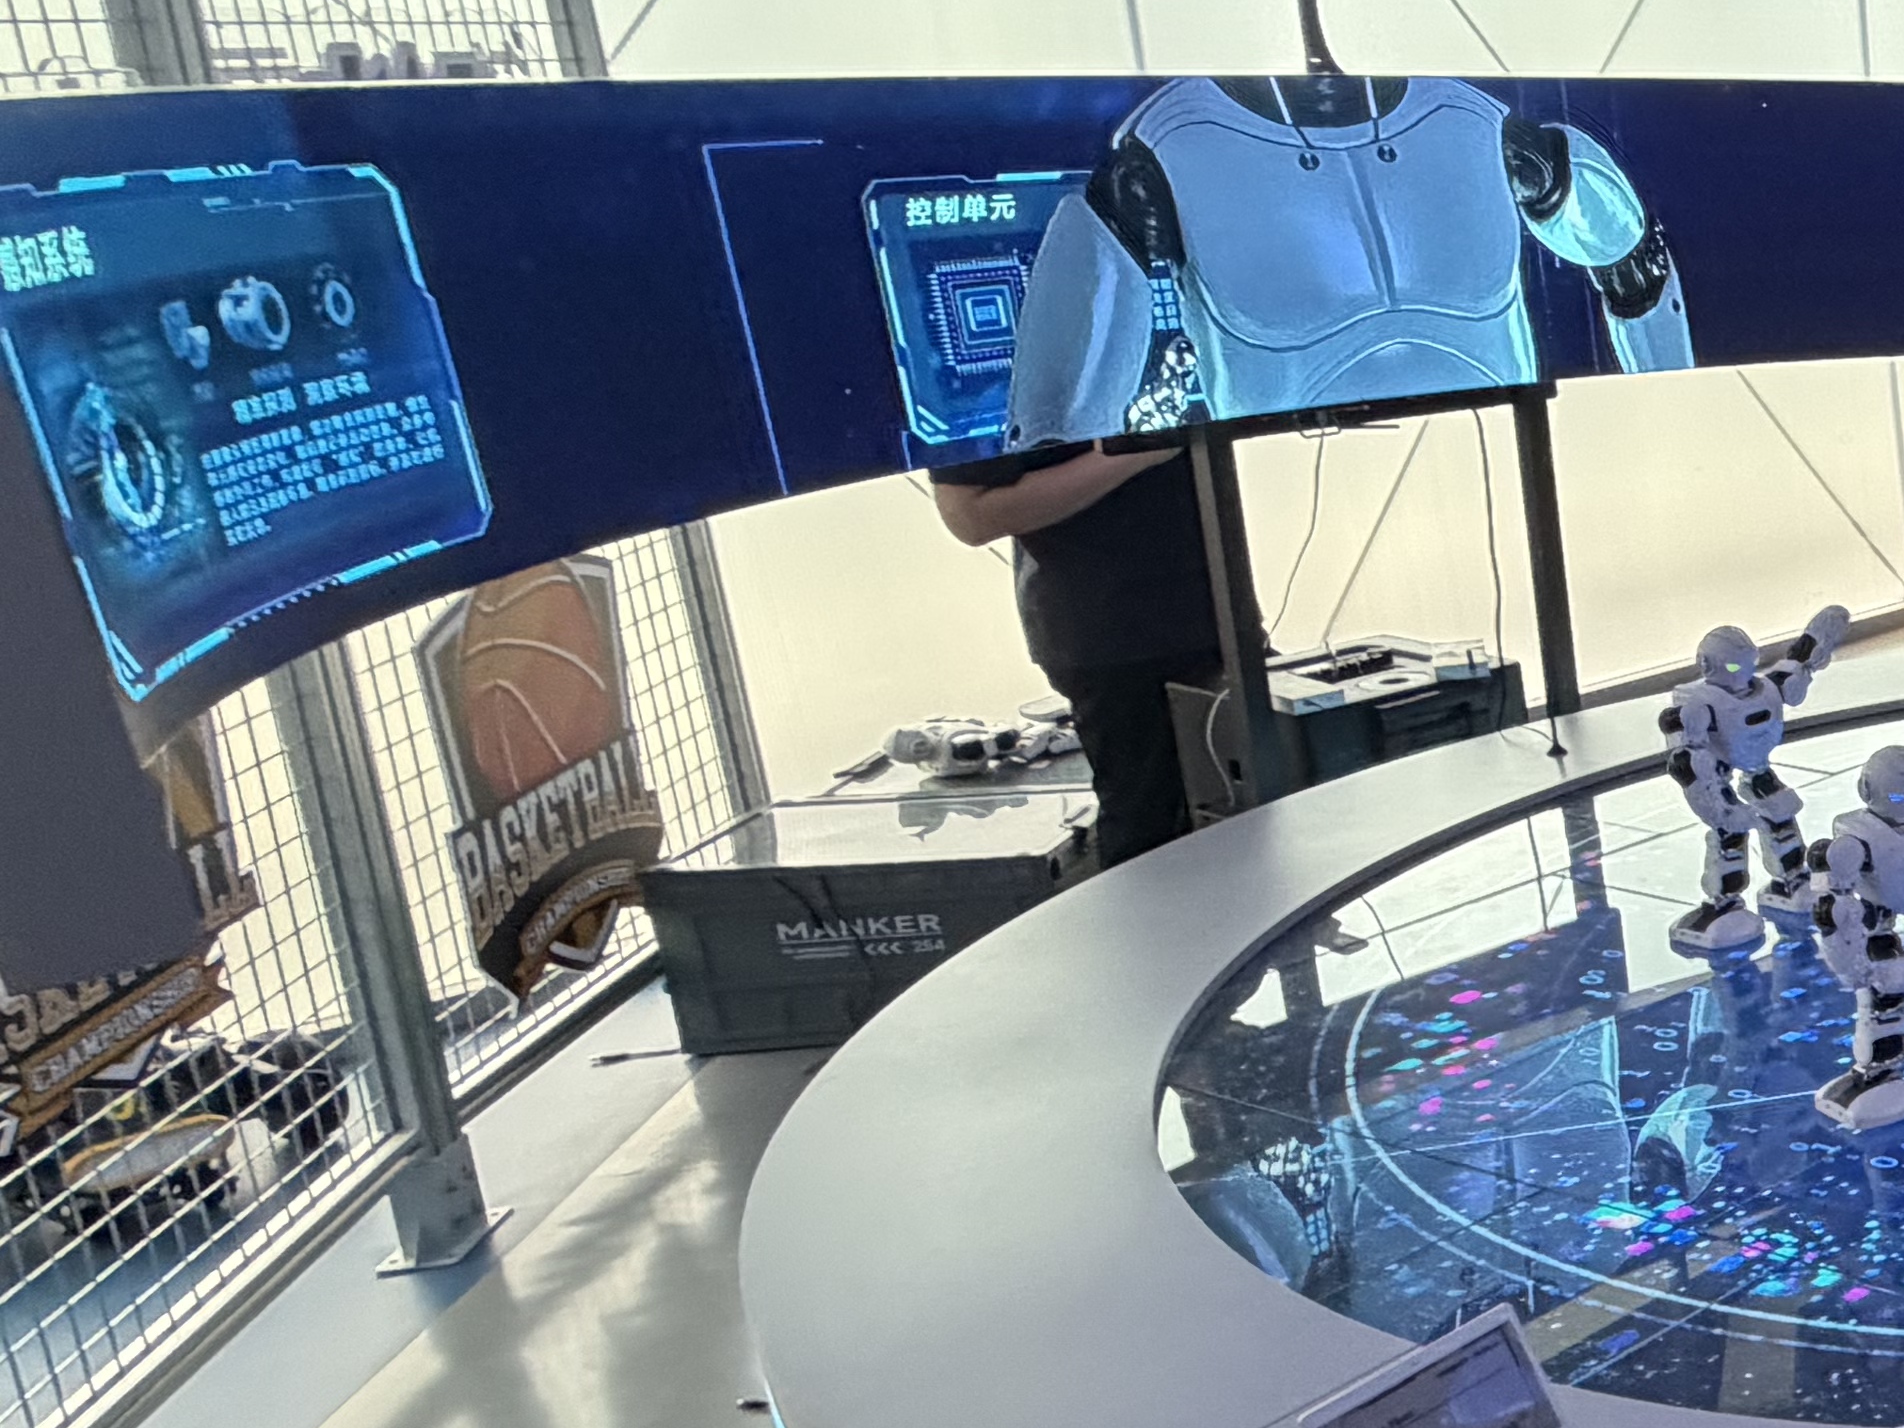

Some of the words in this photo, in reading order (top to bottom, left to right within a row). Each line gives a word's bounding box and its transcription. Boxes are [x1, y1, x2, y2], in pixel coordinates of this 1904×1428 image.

[905, 193, 1016, 227] 控制单元
[777, 913, 943, 942] MANKER
